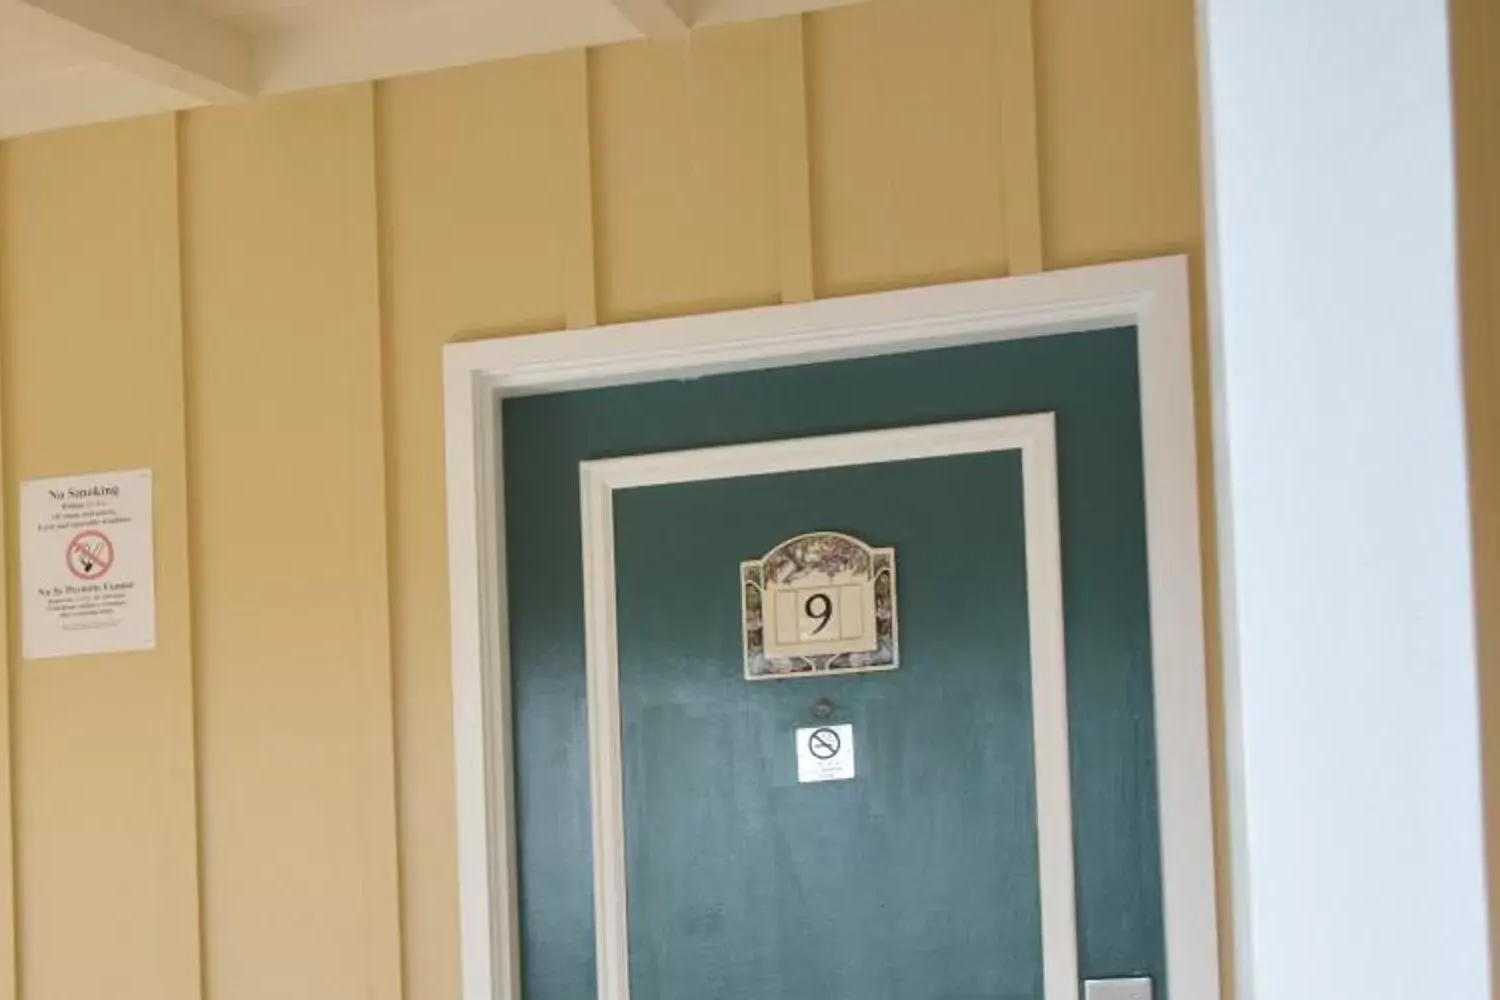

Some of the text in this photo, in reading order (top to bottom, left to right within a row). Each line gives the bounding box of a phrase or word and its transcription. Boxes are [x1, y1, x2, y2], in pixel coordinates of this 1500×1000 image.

[48, 485, 120, 499] No Smoking
[805, 593, 832, 635] 9
